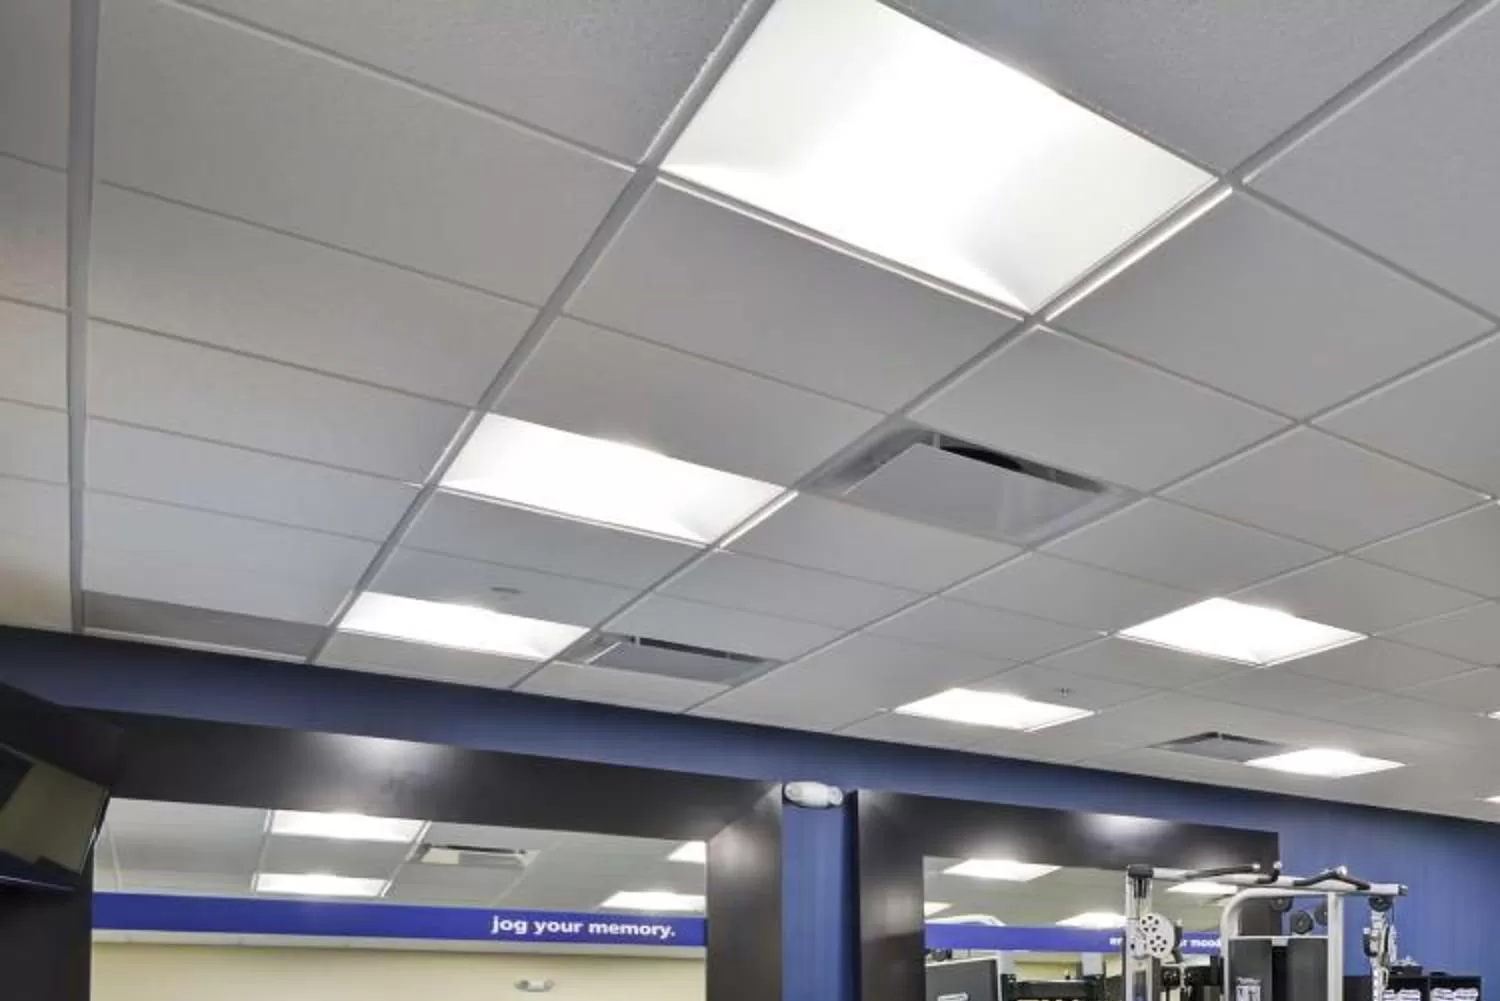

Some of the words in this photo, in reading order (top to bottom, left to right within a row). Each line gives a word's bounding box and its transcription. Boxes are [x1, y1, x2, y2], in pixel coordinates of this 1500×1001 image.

[491, 915, 527, 934] jog
[533, 919, 584, 935] your
[588, 922, 676, 939] memory.
